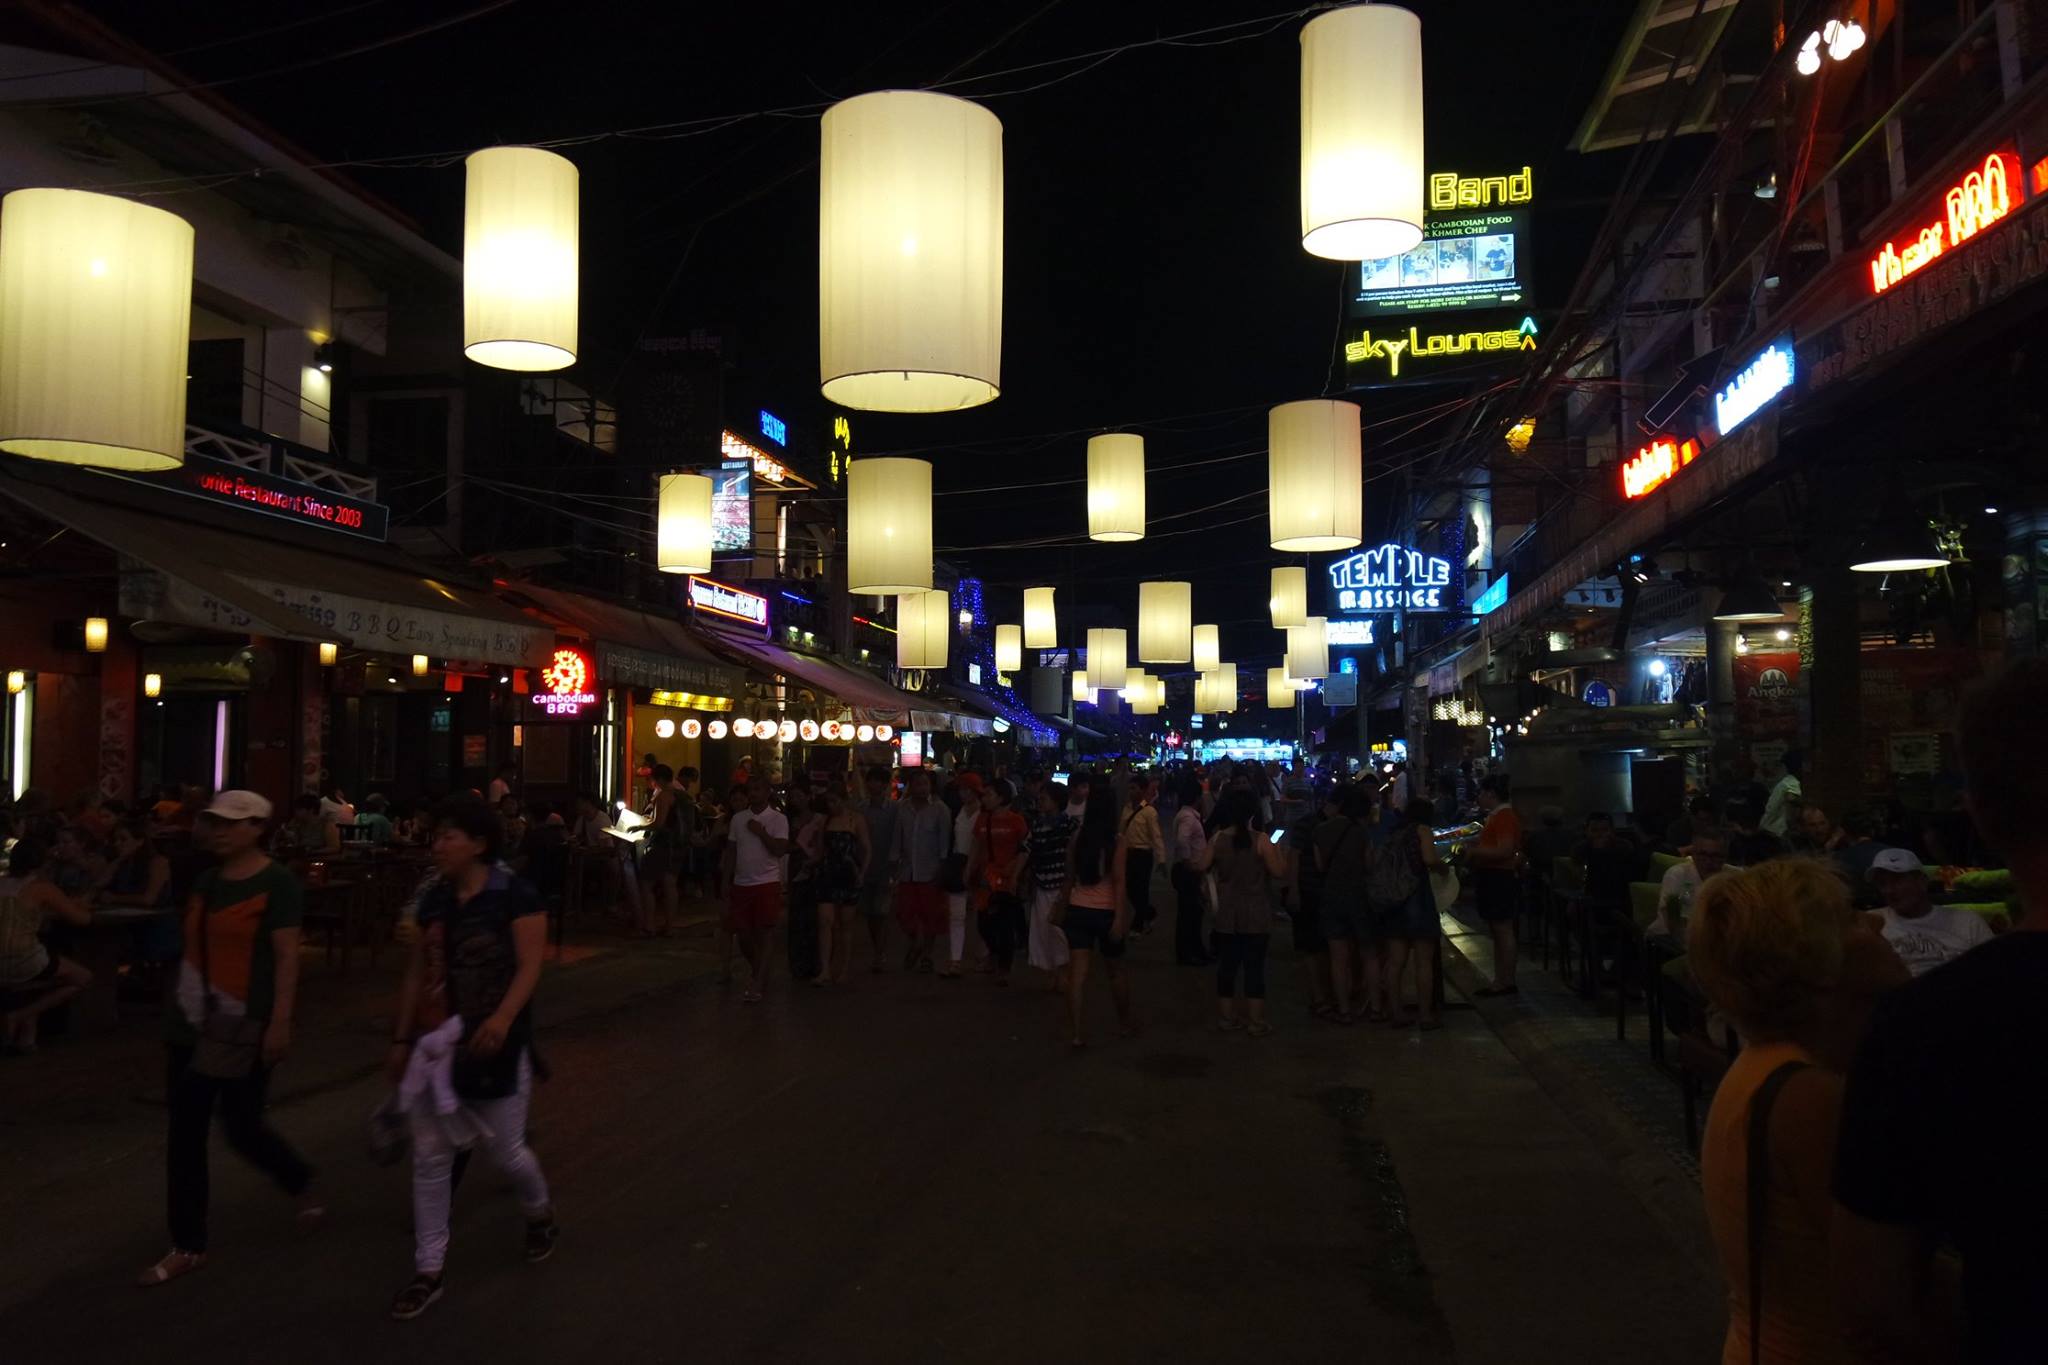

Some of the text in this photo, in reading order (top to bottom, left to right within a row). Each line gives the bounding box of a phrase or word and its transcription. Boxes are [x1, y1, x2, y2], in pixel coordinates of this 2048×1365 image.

[1431, 166, 1532, 210] Band
[1431, 218, 1485, 230] CAMBODIAN
[1487, 216, 1513, 225] FOOD
[1432, 228, 1464, 238] KHMER
[1464, 226, 1488, 236] CHEF
[235, 477, 302, 512] Restaurant
[303, 496, 334, 521] Since
[335, 506, 363, 528] 2003
[1329, 543, 1450, 588] TEMPLE
[1339, 589, 1440, 609] MASSAGE
[547, 703, 578, 714] BBQ
